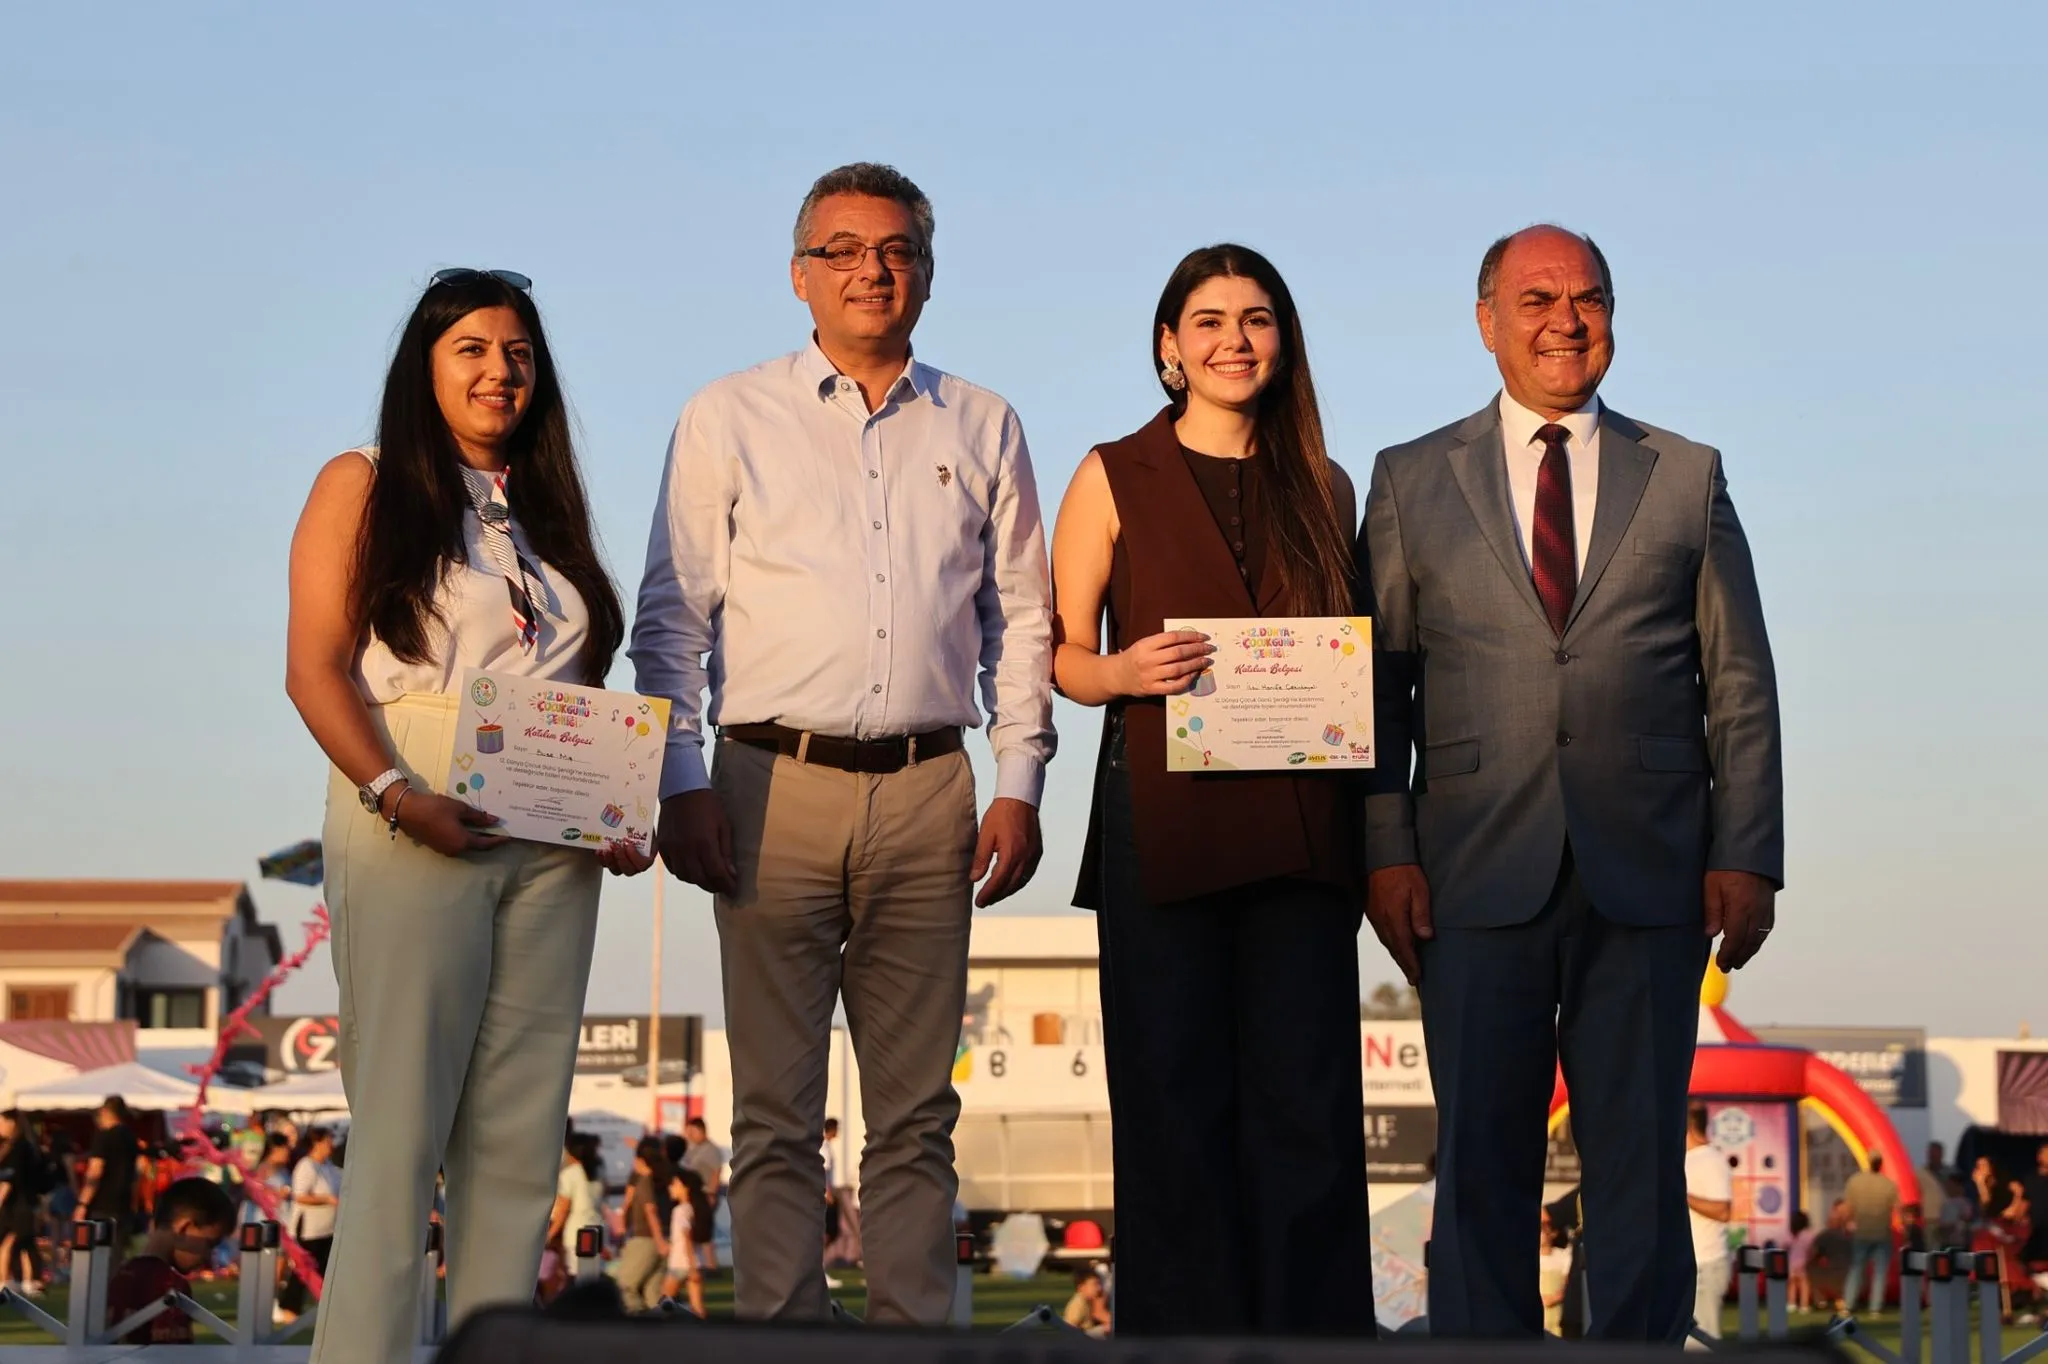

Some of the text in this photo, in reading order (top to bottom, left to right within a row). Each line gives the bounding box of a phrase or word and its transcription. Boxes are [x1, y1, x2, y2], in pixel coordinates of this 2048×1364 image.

[989, 1051, 1006, 1077] 8
[1072, 1050, 1087, 1077] 6
[1365, 1033, 1427, 1069] Ne
